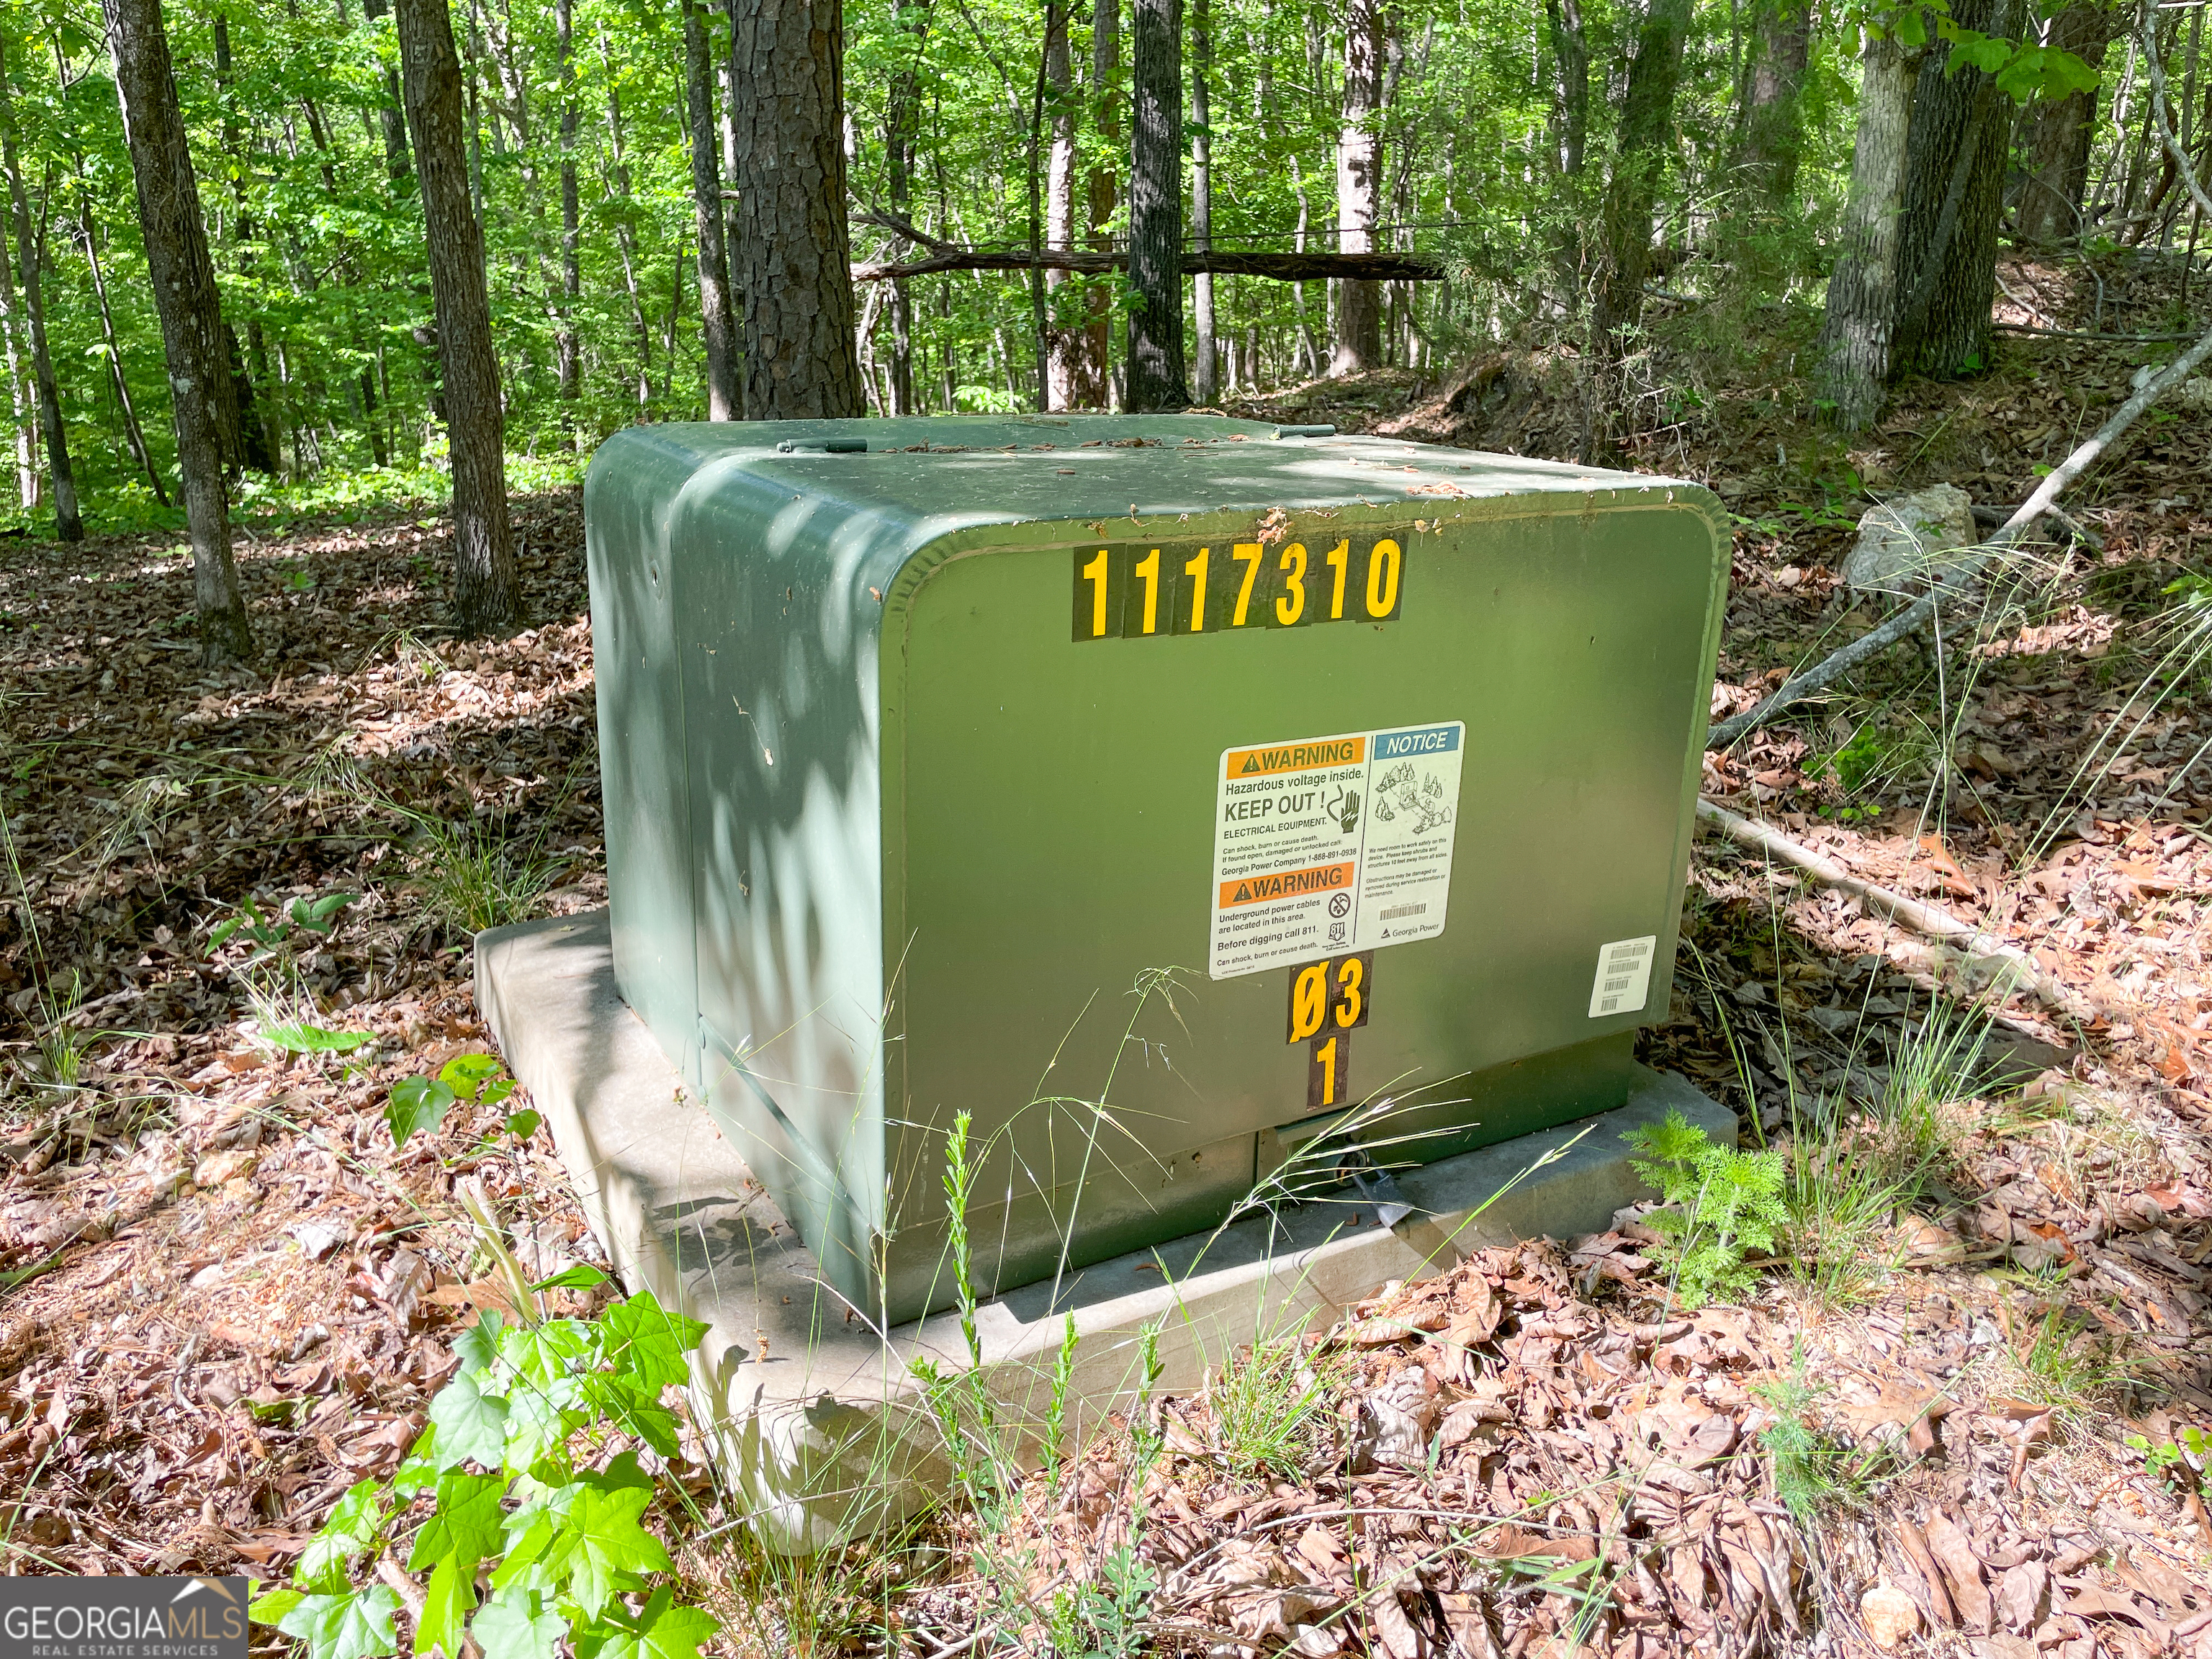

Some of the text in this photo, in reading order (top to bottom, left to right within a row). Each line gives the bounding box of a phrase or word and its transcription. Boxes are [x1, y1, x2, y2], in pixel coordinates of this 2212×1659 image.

[1083, 539, 1401, 637] 1117310
[1387, 732, 1448, 754] NOTICE
[1262, 742, 1353, 770] WARNING
[1226, 769, 1363, 796] Hazardous voltage inside.
[1226, 799, 1273, 822] KEEP
[1279, 792, 1315, 814] OUT
[1224, 817, 1327, 839] ELECTRICAL EQUIPMENT.
[1303, 842, 1328, 850] unlocked
[1222, 848, 1357, 876] Georgia Power Company 1-888-891-0938
[1254, 867, 1342, 897] WARNING
[1219, 899, 1321, 922] Underground power cables
[1233, 920, 1260, 931] located
[1330, 922, 1344, 935] 811
[1393, 928, 1417, 937] Georgia
[1218, 940, 1247, 951] Before
[1249, 933, 1282, 945] digging
[1285, 929, 1300, 938] call
[1317, 1037, 1336, 1105] 1
